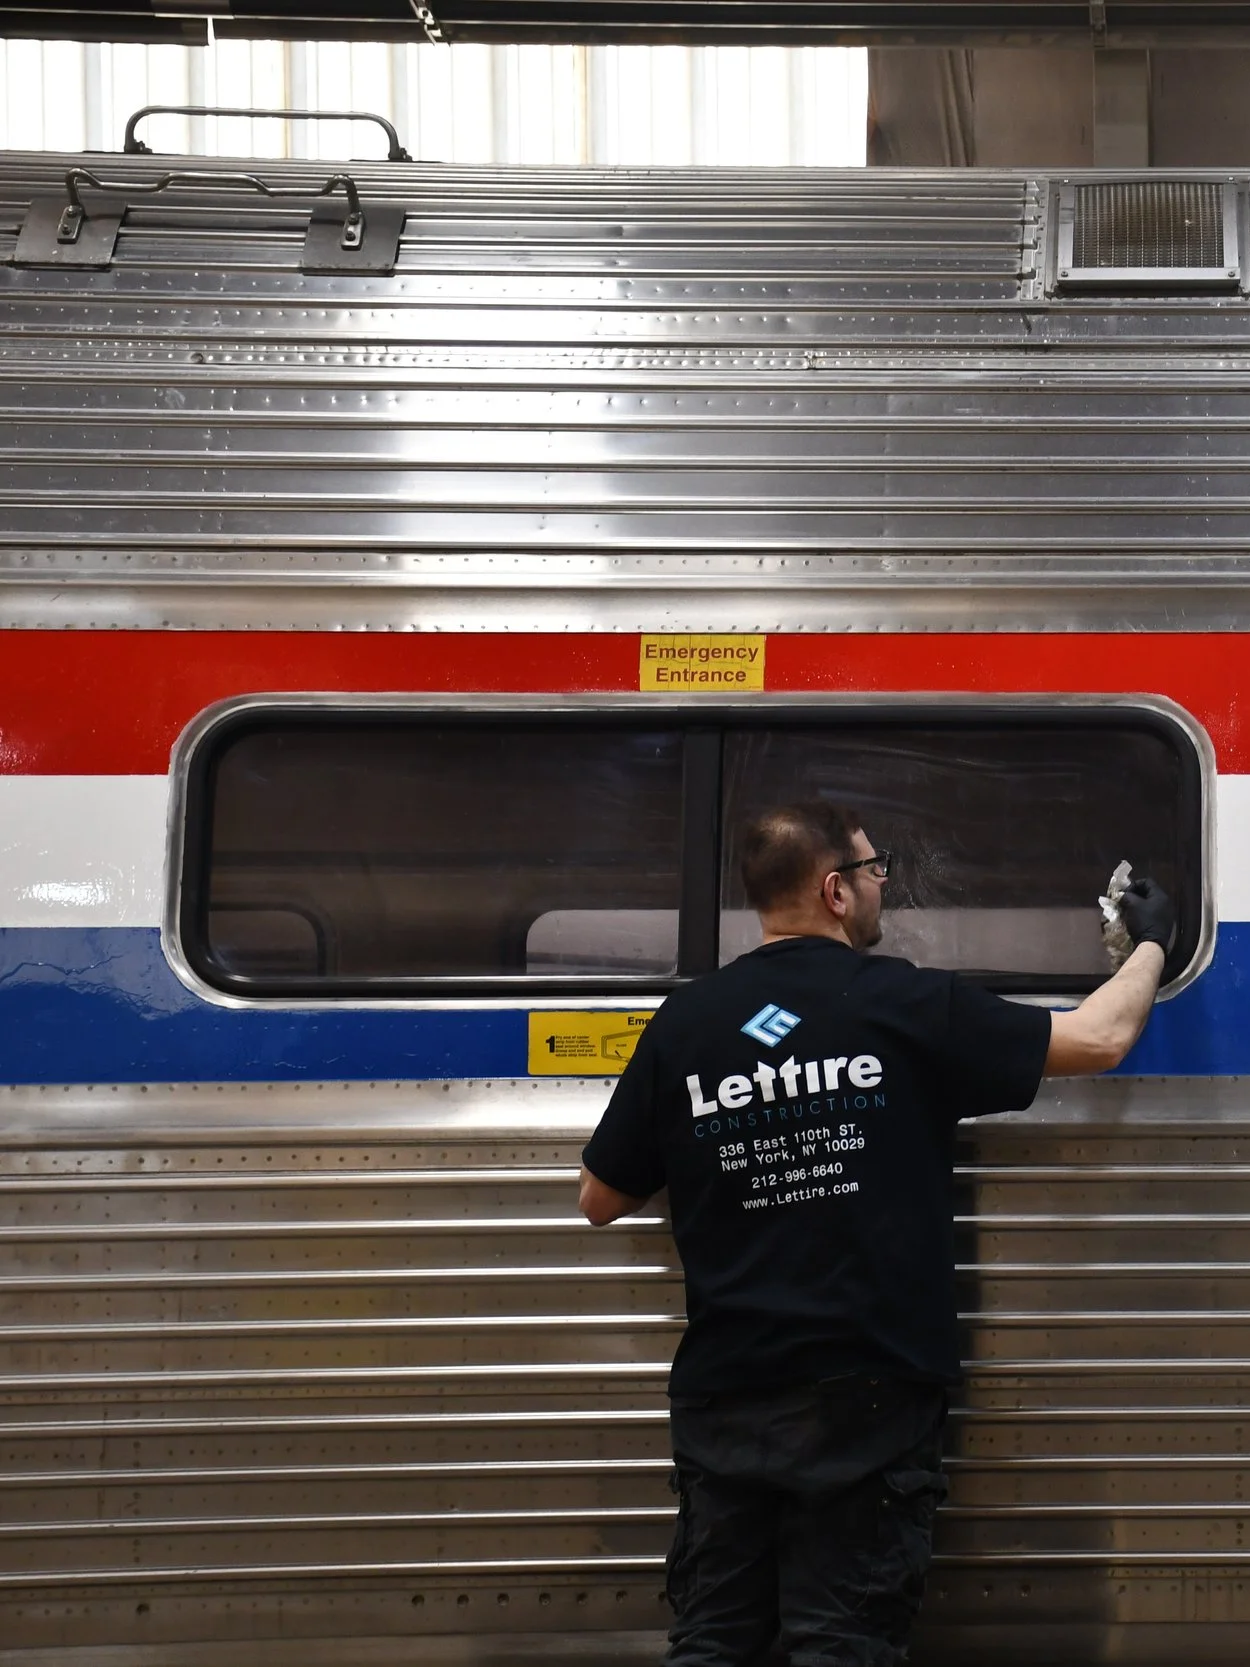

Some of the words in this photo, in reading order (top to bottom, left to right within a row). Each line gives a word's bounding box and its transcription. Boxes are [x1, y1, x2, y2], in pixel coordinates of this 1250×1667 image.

[645, 643, 759, 662] Emergency
[656, 667, 747, 682] Entrance
[546, 1036, 555, 1053] 1
[686, 1055, 883, 1117] Lettire
[694, 1094, 886, 1138] CONSTRUCTION
[719, 1142, 745, 1158] 336
[753, 1136, 787, 1151] East
[794, 1127, 831, 1144] 110th
[839, 1123, 863, 1136] ST.
[721, 1157, 748, 1172] New
[755, 1149, 796, 1166] York,
[802, 1143, 817, 1157] NY
[825, 1137, 865, 1153] 10029
[751, 1162, 843, 1189] 212-996-6640
[742, 1181, 859, 1210] www.Lettire.com
